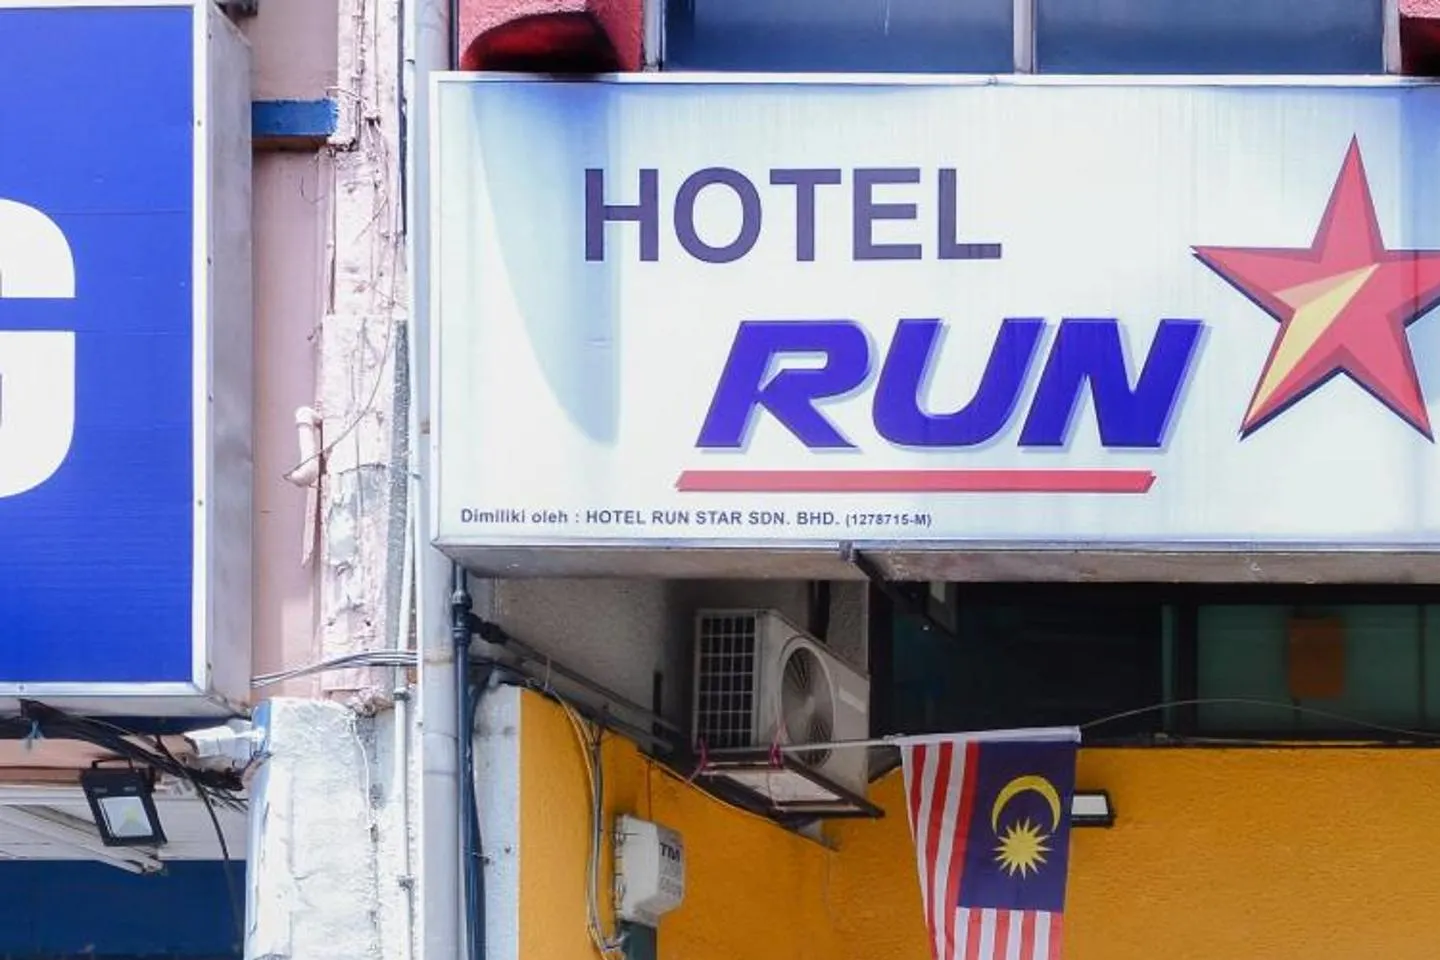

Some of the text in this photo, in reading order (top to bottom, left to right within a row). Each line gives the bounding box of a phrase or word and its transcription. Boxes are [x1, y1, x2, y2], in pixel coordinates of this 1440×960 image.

[584, 167, 1003, 263] HOTEL
[694, 317, 1210, 452] RUN
[460, 508, 526, 525] Dimiliki
[531, 508, 568, 525] oleh
[586, 509, 646, 526] HOTEL
[652, 509, 690, 526] RUN
[695, 509, 742, 526] STAR
[748, 509, 790, 526] SDN.
[797, 509, 841, 527] BHD.
